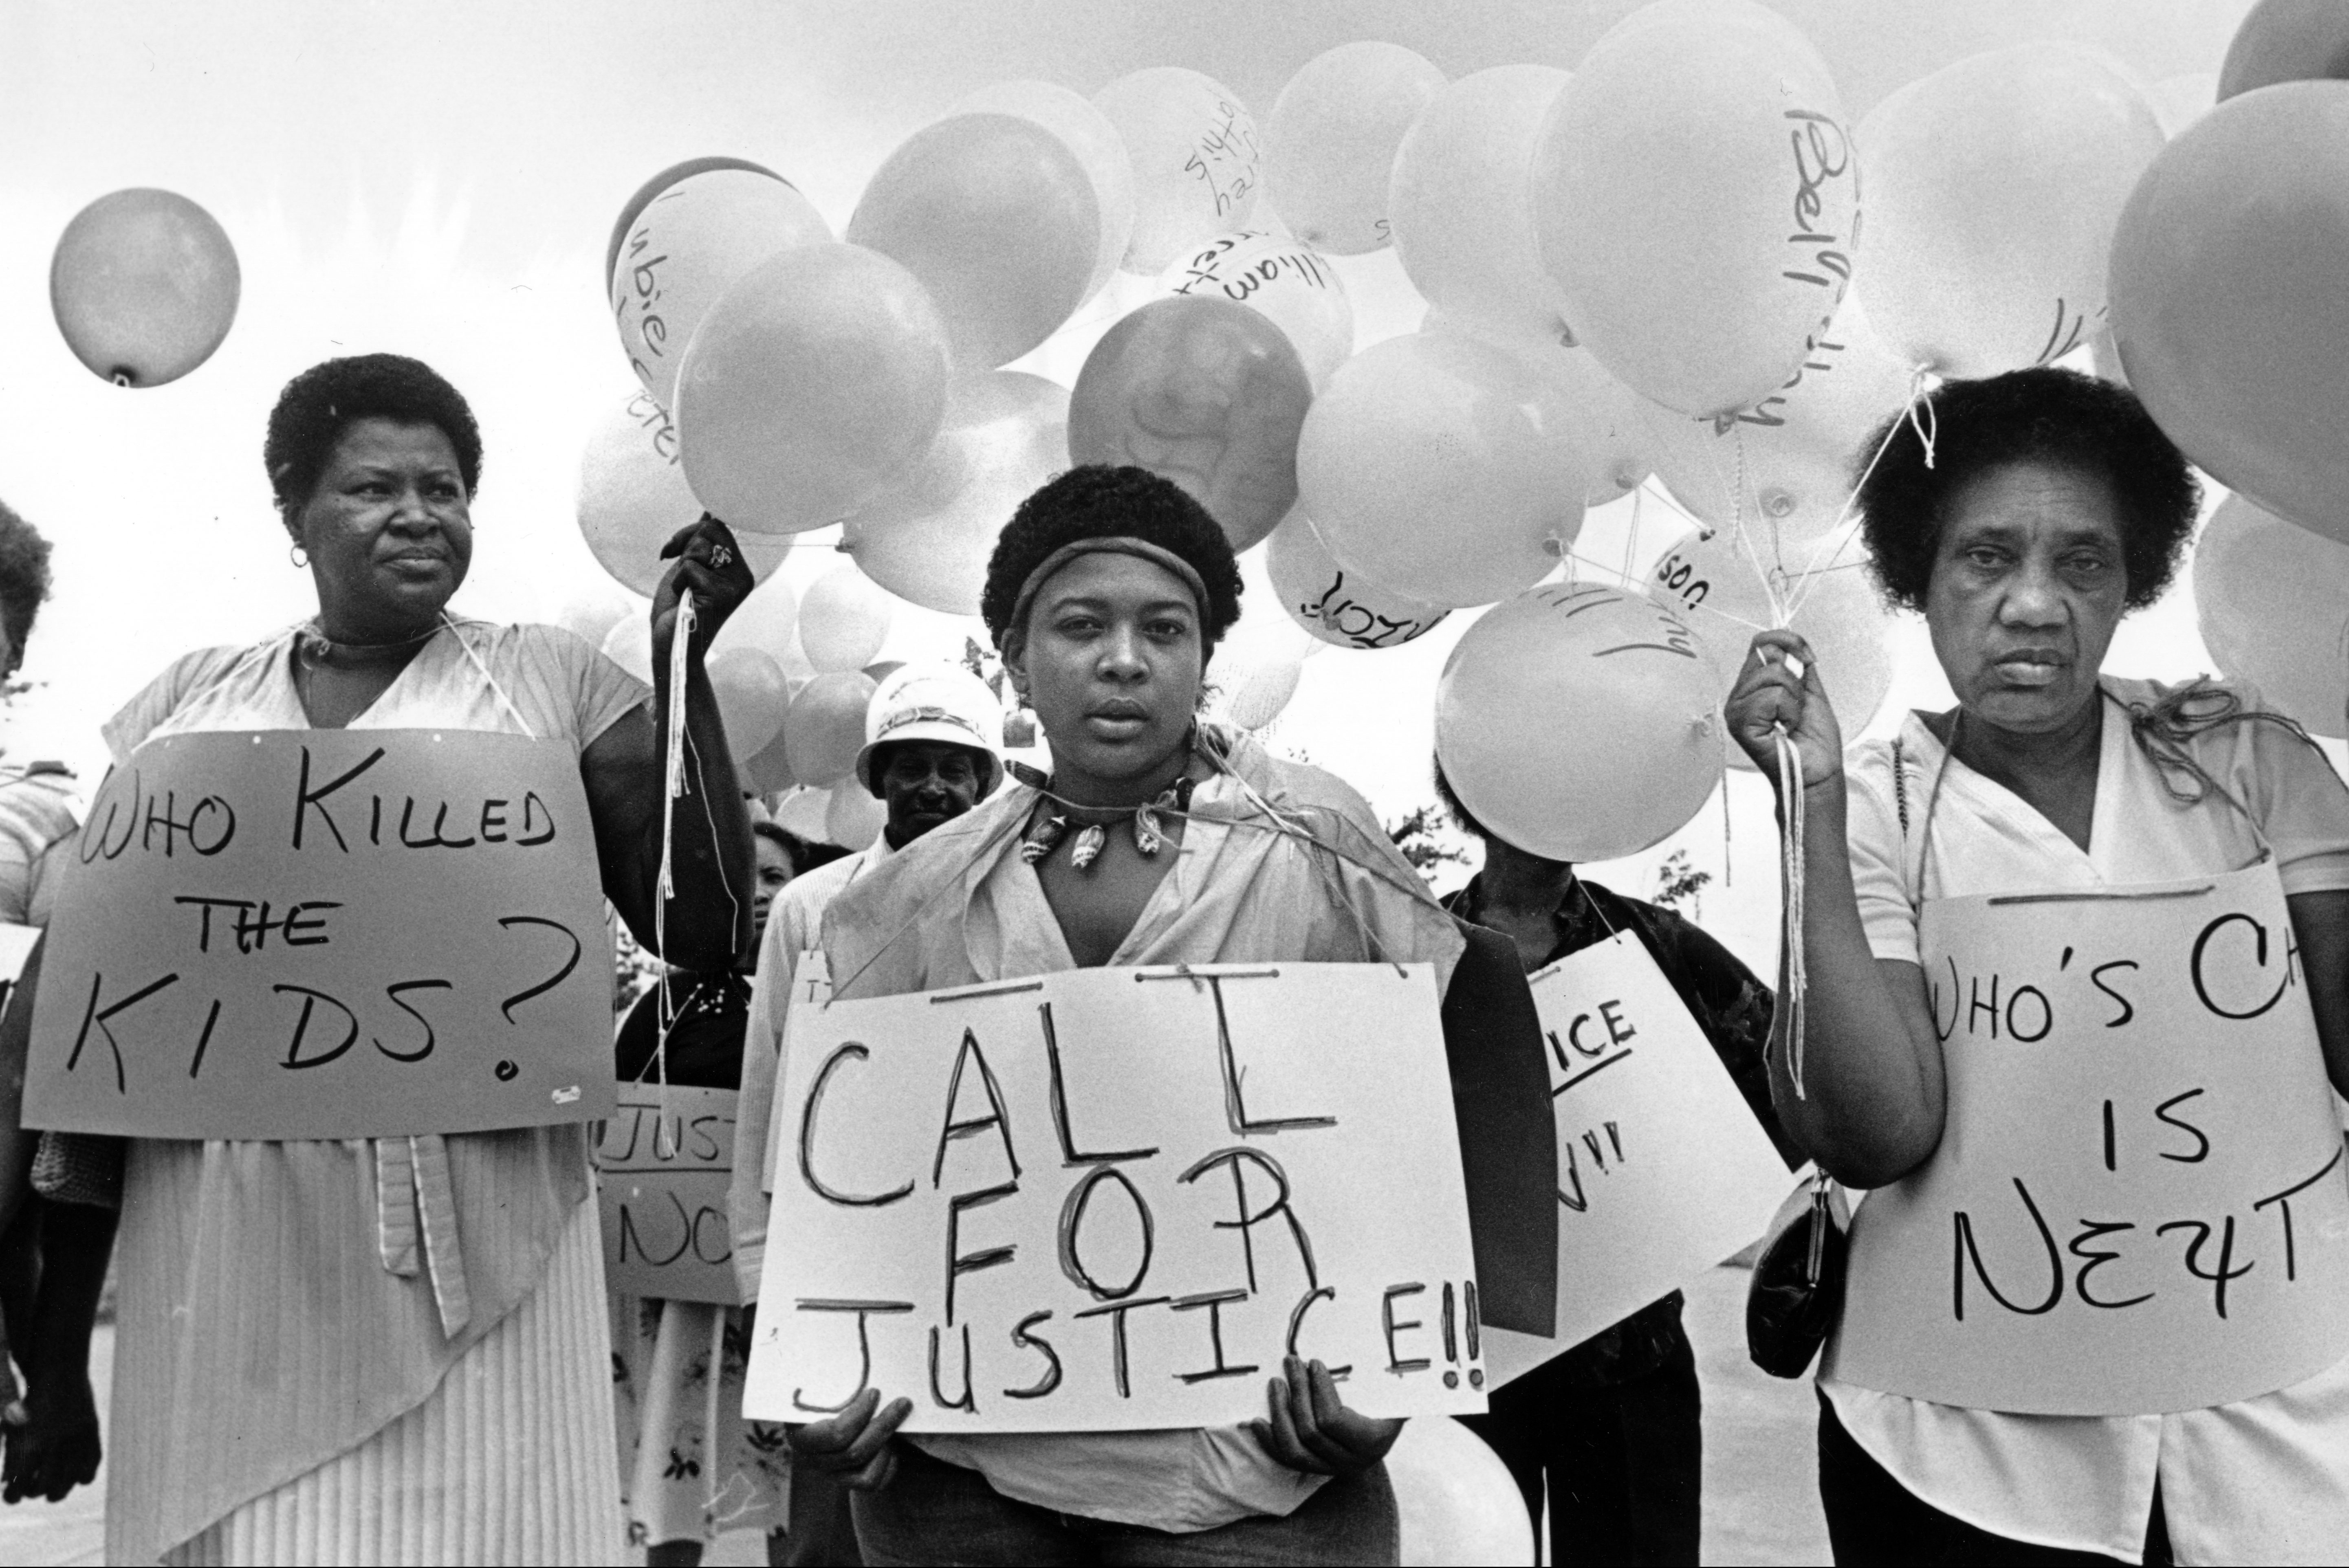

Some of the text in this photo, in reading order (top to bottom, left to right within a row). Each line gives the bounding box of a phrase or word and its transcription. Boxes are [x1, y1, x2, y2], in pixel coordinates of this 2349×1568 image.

[82, 745, 555, 863] WHO KILLED
[174, 896, 345, 954] THE
[599, 1103, 736, 1161] JUS
[797, 974, 1339, 1207] CALL
[2103, 1088, 2210, 1172] IS
[946, 1146, 1317, 1328] FOR
[1954, 1145, 2343, 1322] NEXT
